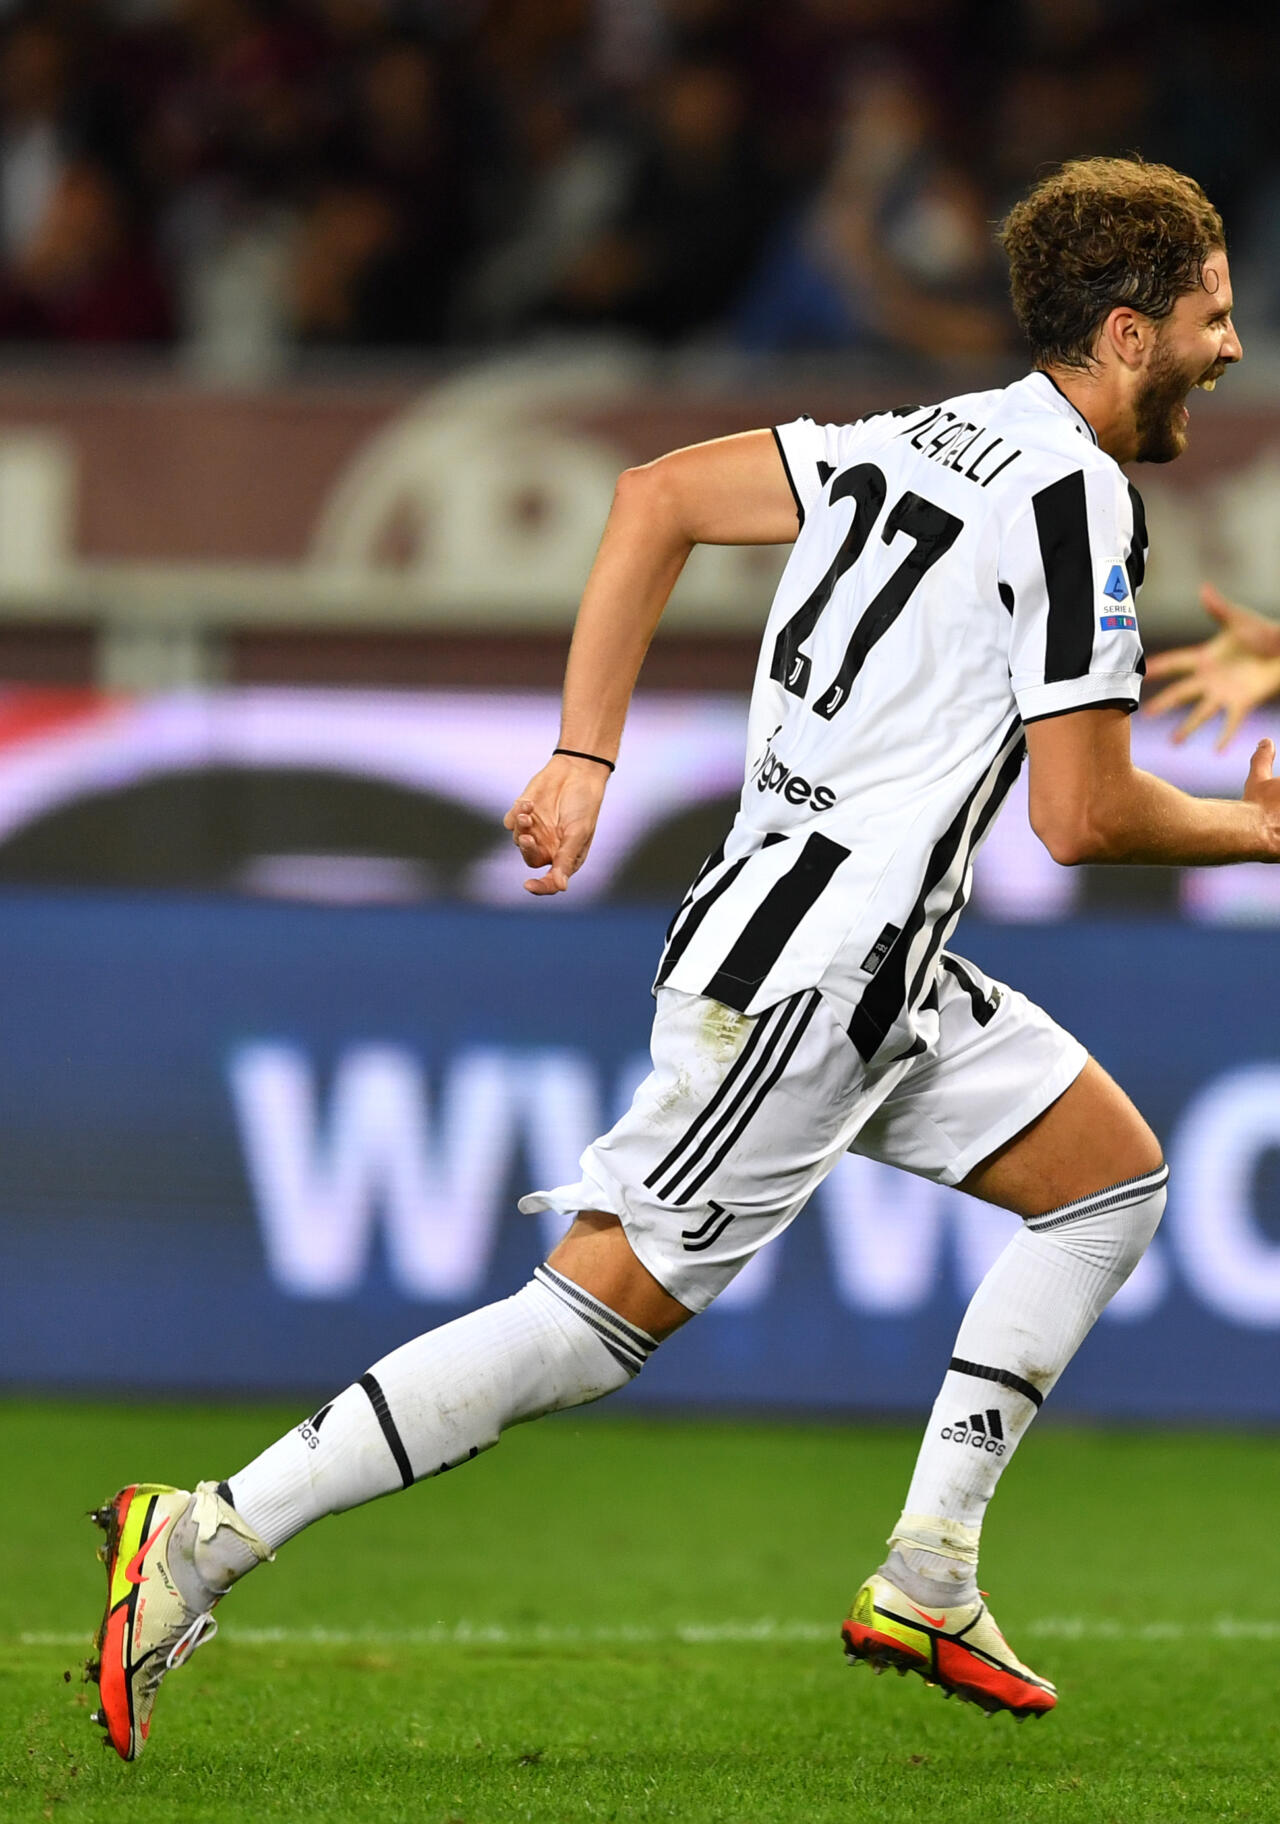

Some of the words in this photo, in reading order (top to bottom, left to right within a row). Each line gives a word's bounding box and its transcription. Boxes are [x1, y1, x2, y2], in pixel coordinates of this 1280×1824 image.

[769, 462, 965, 721] 27
[1103, 605, 1127, 614] SERIE
[941, 1427, 1006, 1457] adidas
